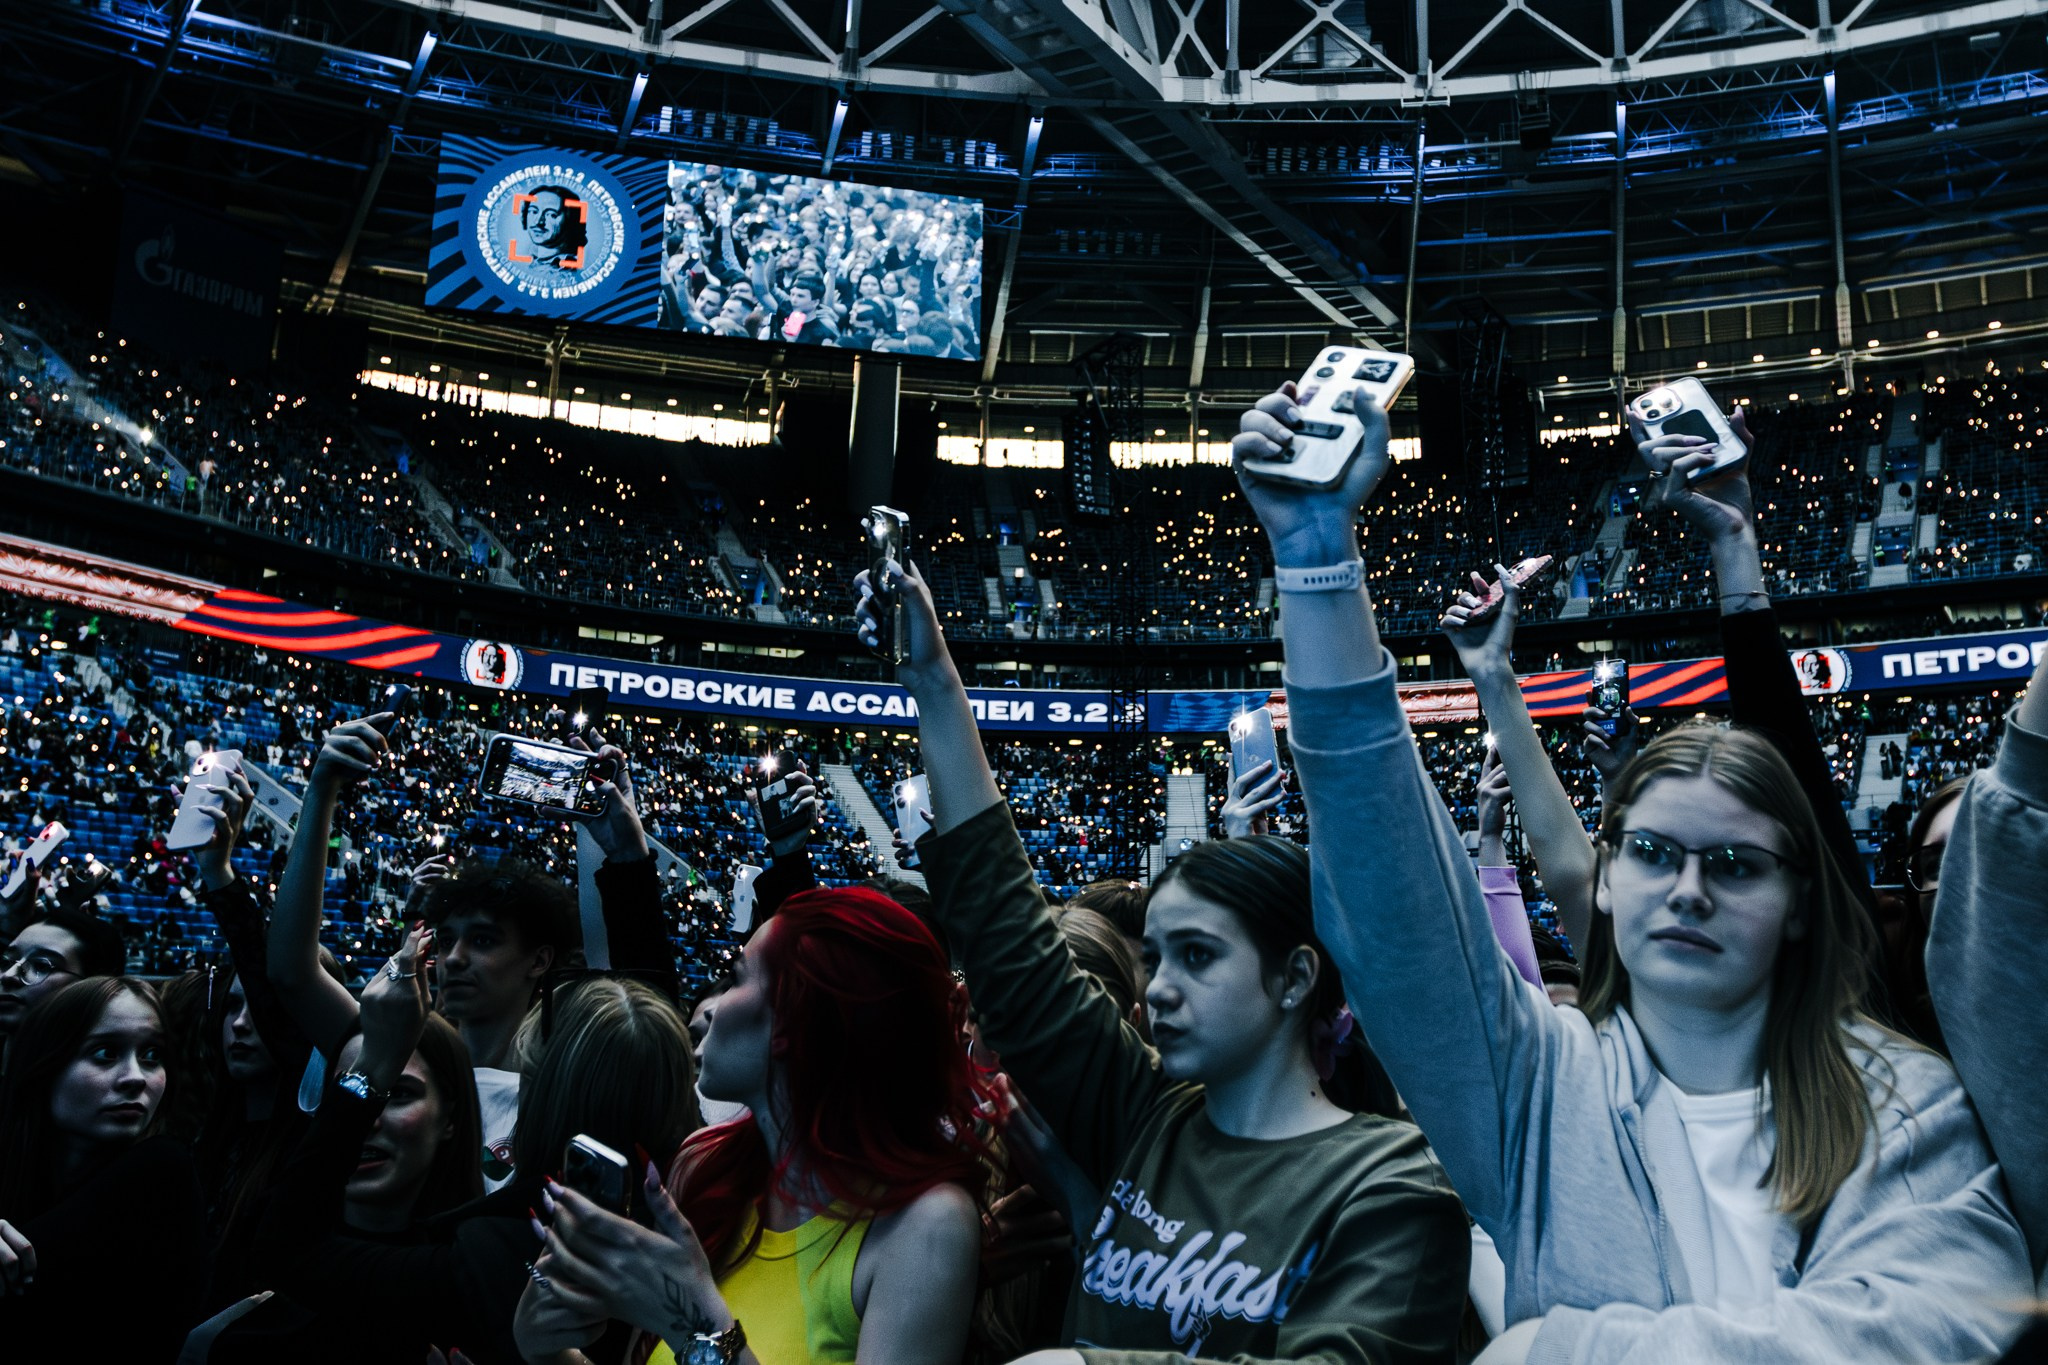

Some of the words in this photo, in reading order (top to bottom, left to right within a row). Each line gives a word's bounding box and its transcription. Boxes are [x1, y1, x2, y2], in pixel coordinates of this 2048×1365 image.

[477, 208, 515, 285] ПЕТРОВСКИЕ
[553, 165, 585, 182] 3.2.2
[587, 179, 624, 254] ПЕТРОВСКИЕ
[173, 268, 263, 318] ГАЗПРОМ
[517, 280, 549, 299] 3.2.2
[550, 662, 796, 711] ПЕТРОВСКИЕ
